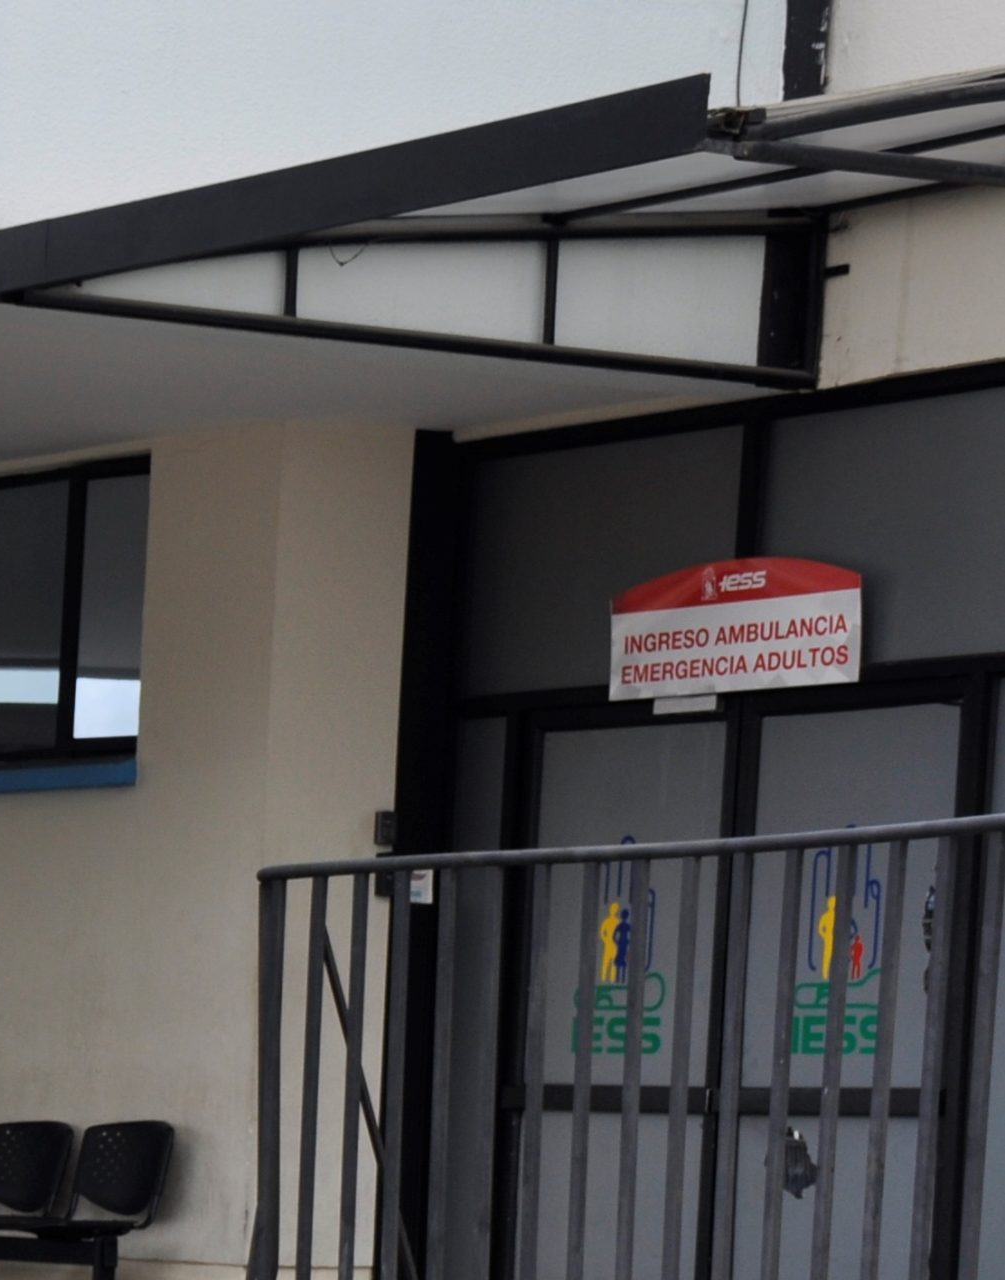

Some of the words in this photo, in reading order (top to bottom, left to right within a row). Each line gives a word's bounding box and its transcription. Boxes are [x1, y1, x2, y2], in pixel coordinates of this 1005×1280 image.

[624, 627, 710, 654] INGRESO
[715, 613, 848, 646] AMBULANCIA
[621, 654, 748, 684] EMERGENCIA
[753, 644, 849, 673] ADULTOS
